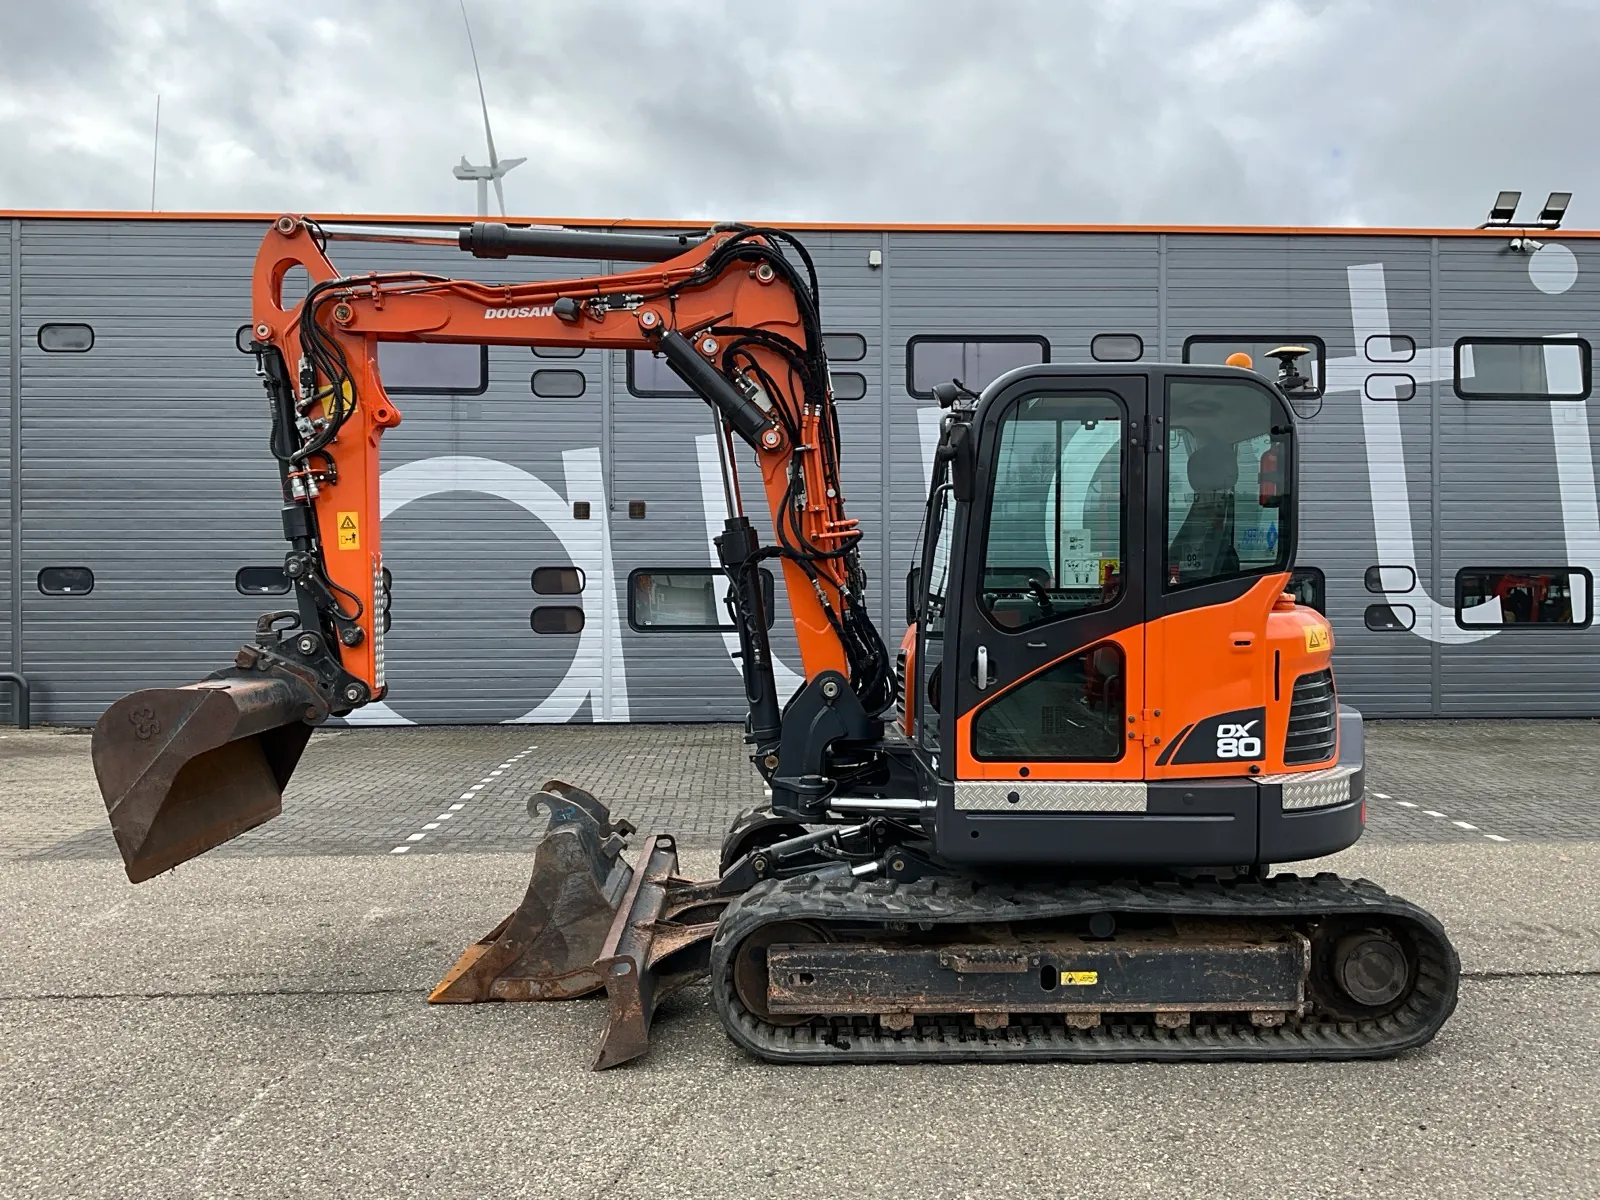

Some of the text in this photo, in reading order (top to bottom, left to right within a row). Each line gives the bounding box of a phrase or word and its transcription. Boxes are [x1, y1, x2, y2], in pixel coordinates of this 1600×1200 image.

[484, 306, 554, 319] DOOSAN
[1216, 719, 1260, 738] DX
[1216, 737, 1262, 758] 80
